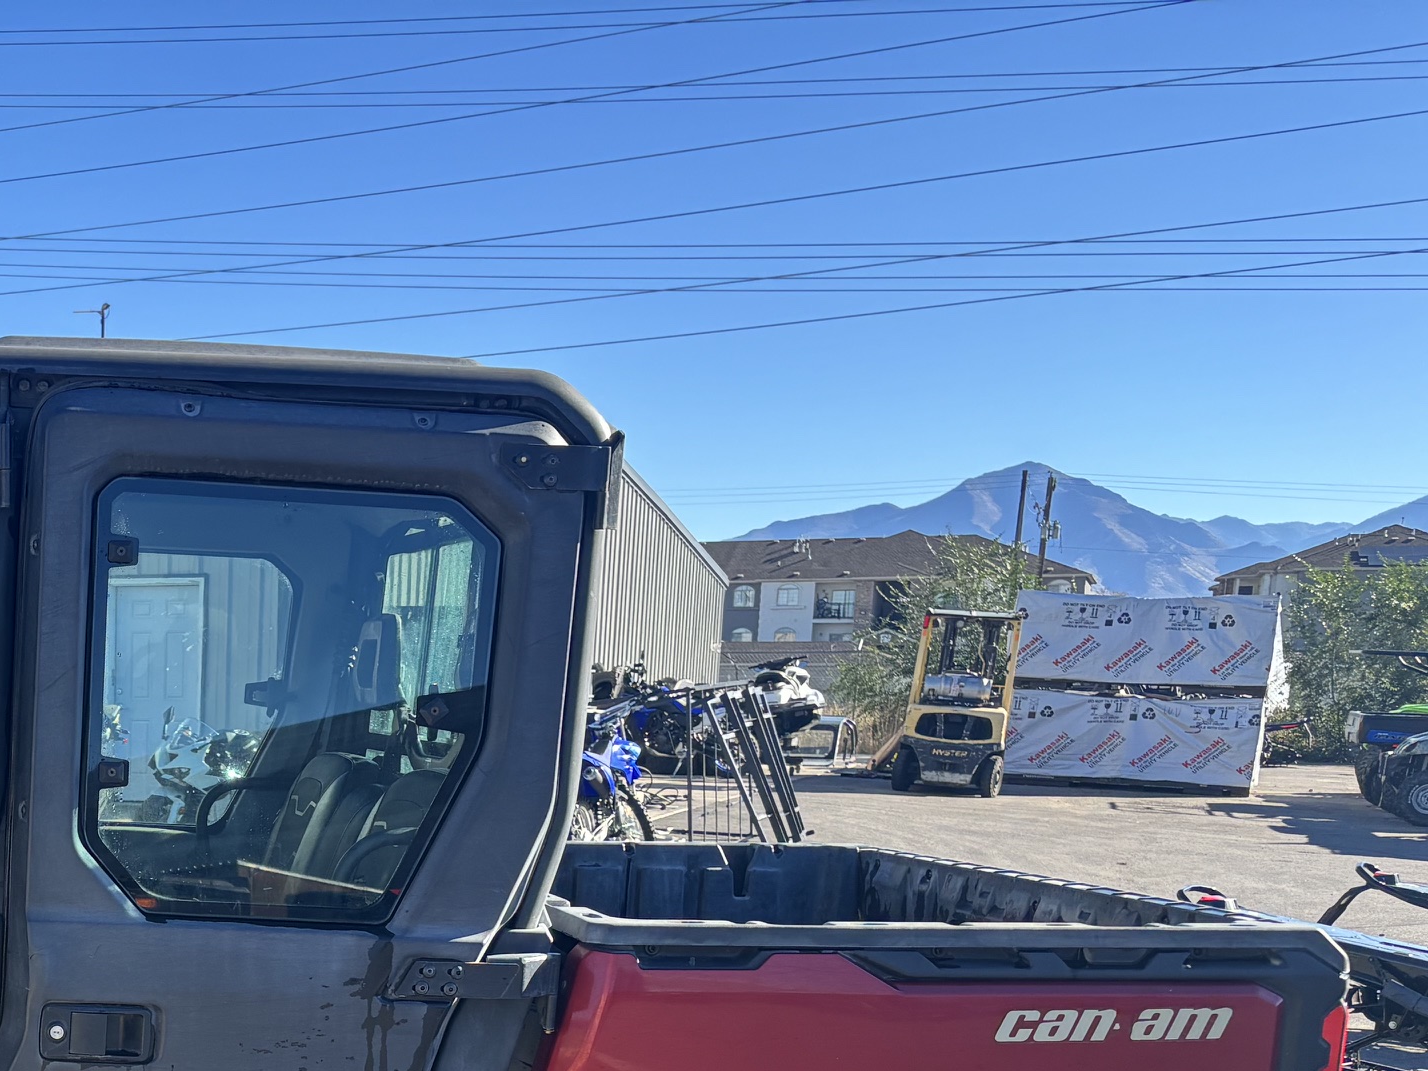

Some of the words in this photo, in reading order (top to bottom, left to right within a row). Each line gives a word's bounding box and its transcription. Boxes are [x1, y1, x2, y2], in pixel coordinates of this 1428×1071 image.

[1017, 633, 1043, 657] wasaki
[1052, 634, 1094, 666] Kawasaki
[1062, 658, 1080, 672] UTILITY
[1080, 642, 1100, 659] VEHICLE
[1104, 638, 1147, 671] Kawasaki
[1156, 637, 1199, 670] Kawasaki
[1167, 662, 1185, 677] UTILITY
[1185, 645, 1206, 663] VEHICLE
[1210, 640, 1253, 673] Kawasaki
[1114, 663, 1132, 678] UTILITY
[1132, 647, 1153, 664] VEHICLE
[1221, 666, 1240, 681] UTILITY
[1239, 649, 1260, 666] VEHICLE
[1027, 731, 1068, 762] Kawasaki
[1078, 730, 1120, 762] Kawasaki
[1129, 734, 1171, 766] Kawasaki
[1182, 736, 1224, 768] Kawasaki
